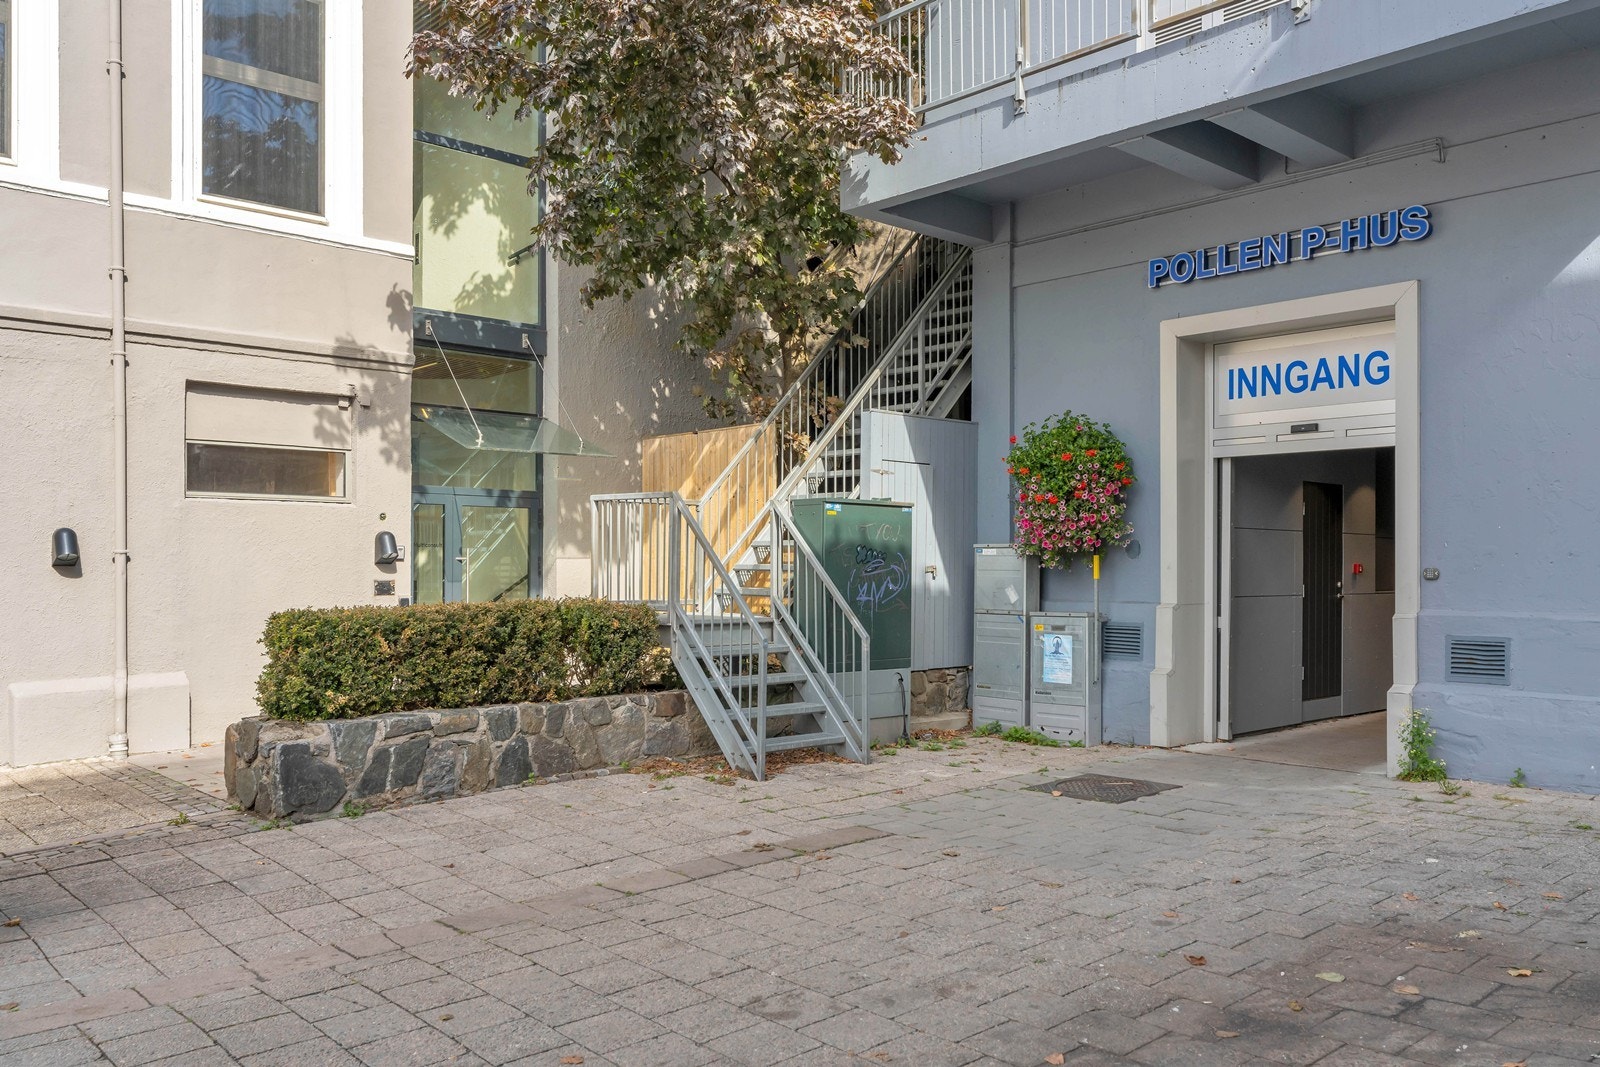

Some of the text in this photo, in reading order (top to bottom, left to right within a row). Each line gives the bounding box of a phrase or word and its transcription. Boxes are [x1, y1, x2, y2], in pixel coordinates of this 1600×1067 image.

[1147, 204, 1432, 289] POLLEN P-HUS
[1228, 350, 1390, 400] INNGANG
